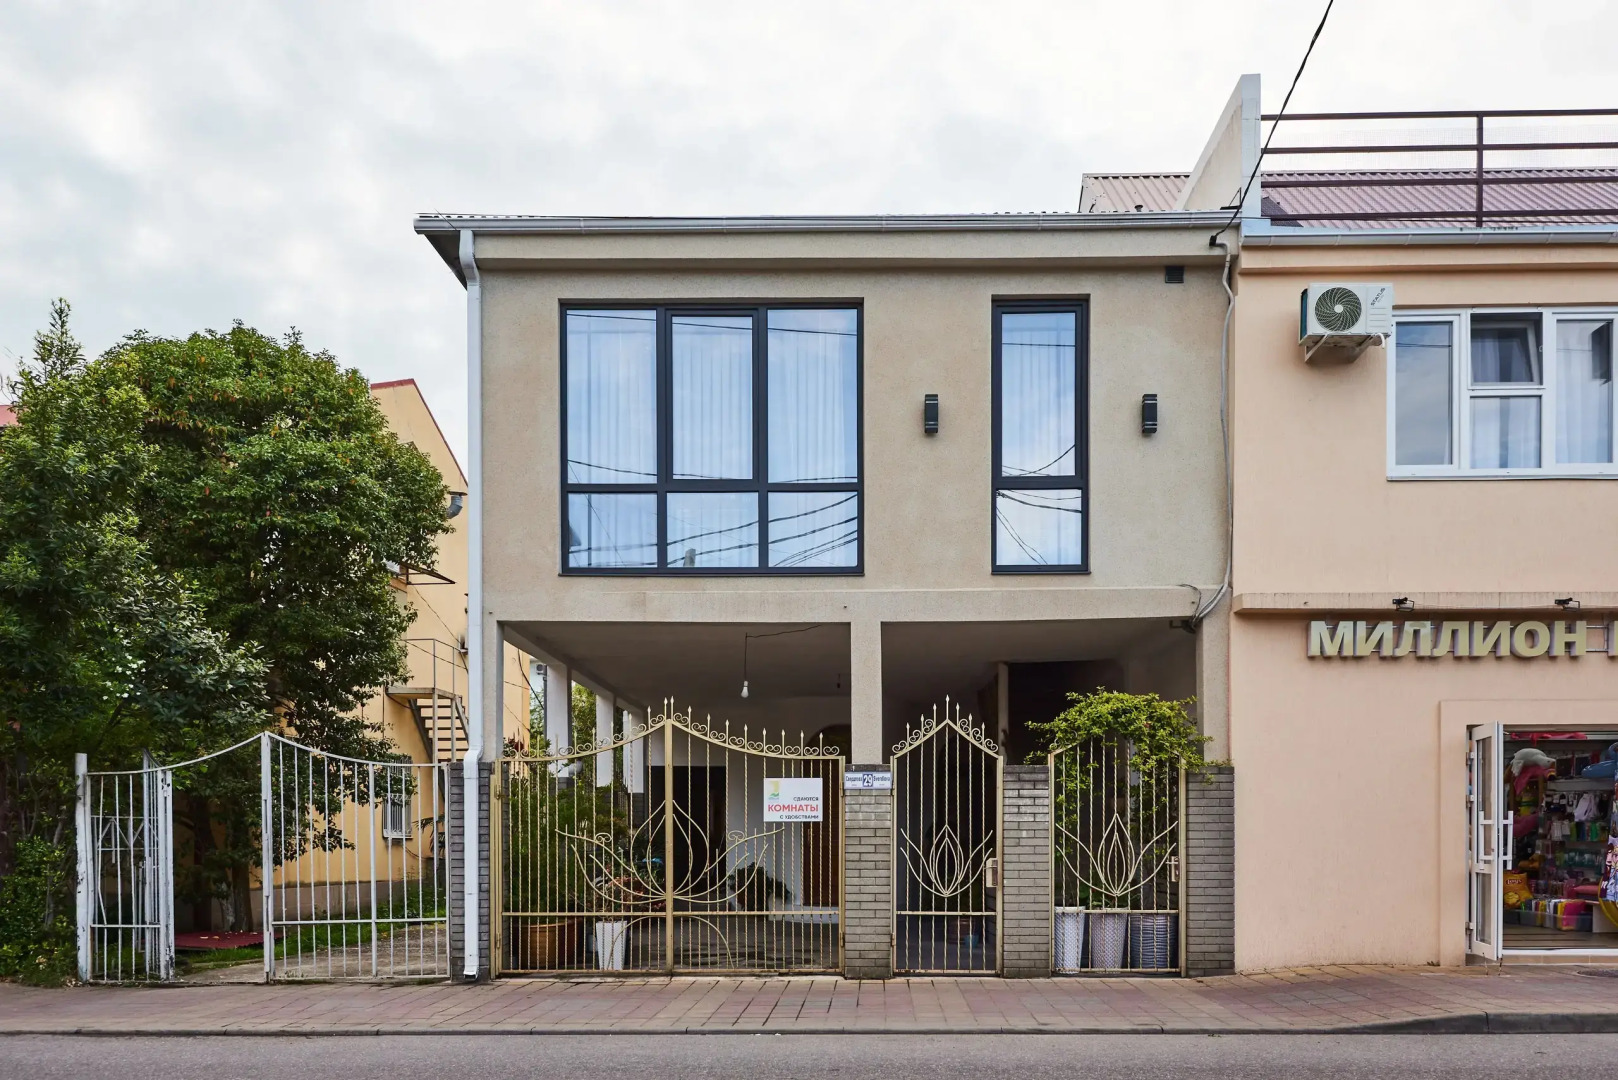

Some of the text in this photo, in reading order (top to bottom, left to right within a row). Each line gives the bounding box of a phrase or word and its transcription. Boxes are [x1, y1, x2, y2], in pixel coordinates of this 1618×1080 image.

[1308, 620, 1587, 657] МИЛЛИОН
[863, 774, 873, 787] 29
[767, 804, 819, 812] КОМНАТЫ
